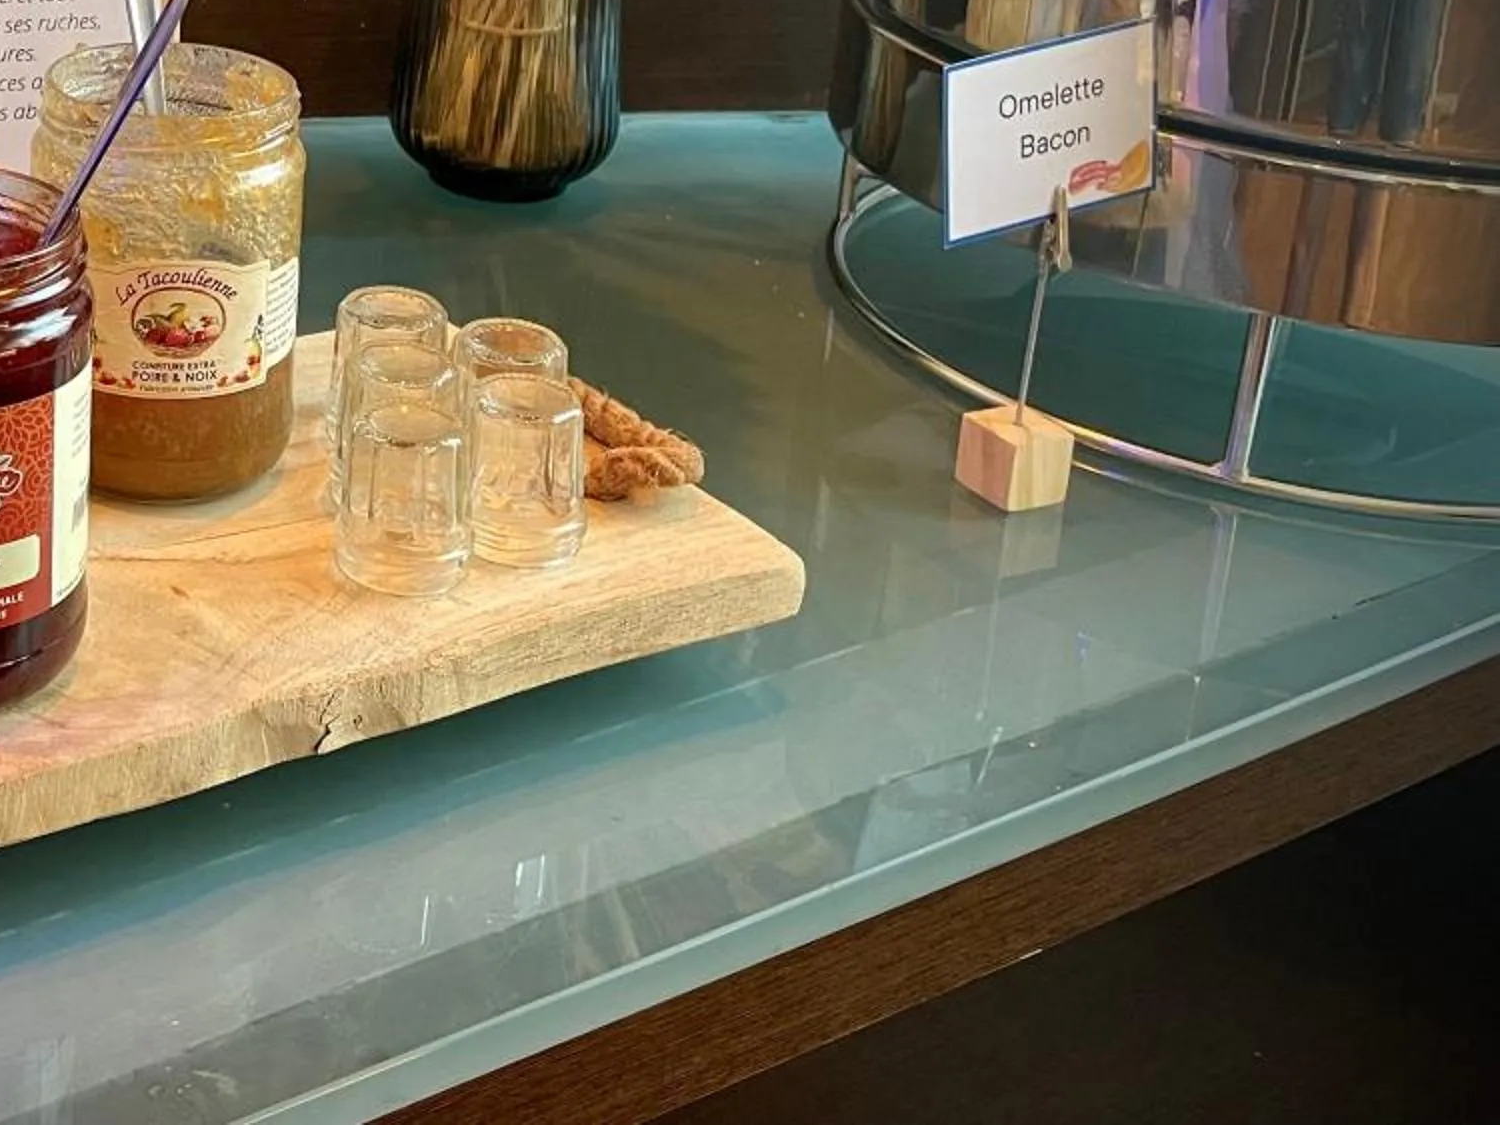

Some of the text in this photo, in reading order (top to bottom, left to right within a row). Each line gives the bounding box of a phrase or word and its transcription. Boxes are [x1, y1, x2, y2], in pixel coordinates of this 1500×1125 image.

[4, 18, 33, 33] ses
[999, 78, 1104, 119] Omelette
[1020, 125, 1091, 159] Bacon
[115, 267, 239, 306] La Tacoulienne
[185, 370, 217, 383] NOIX
